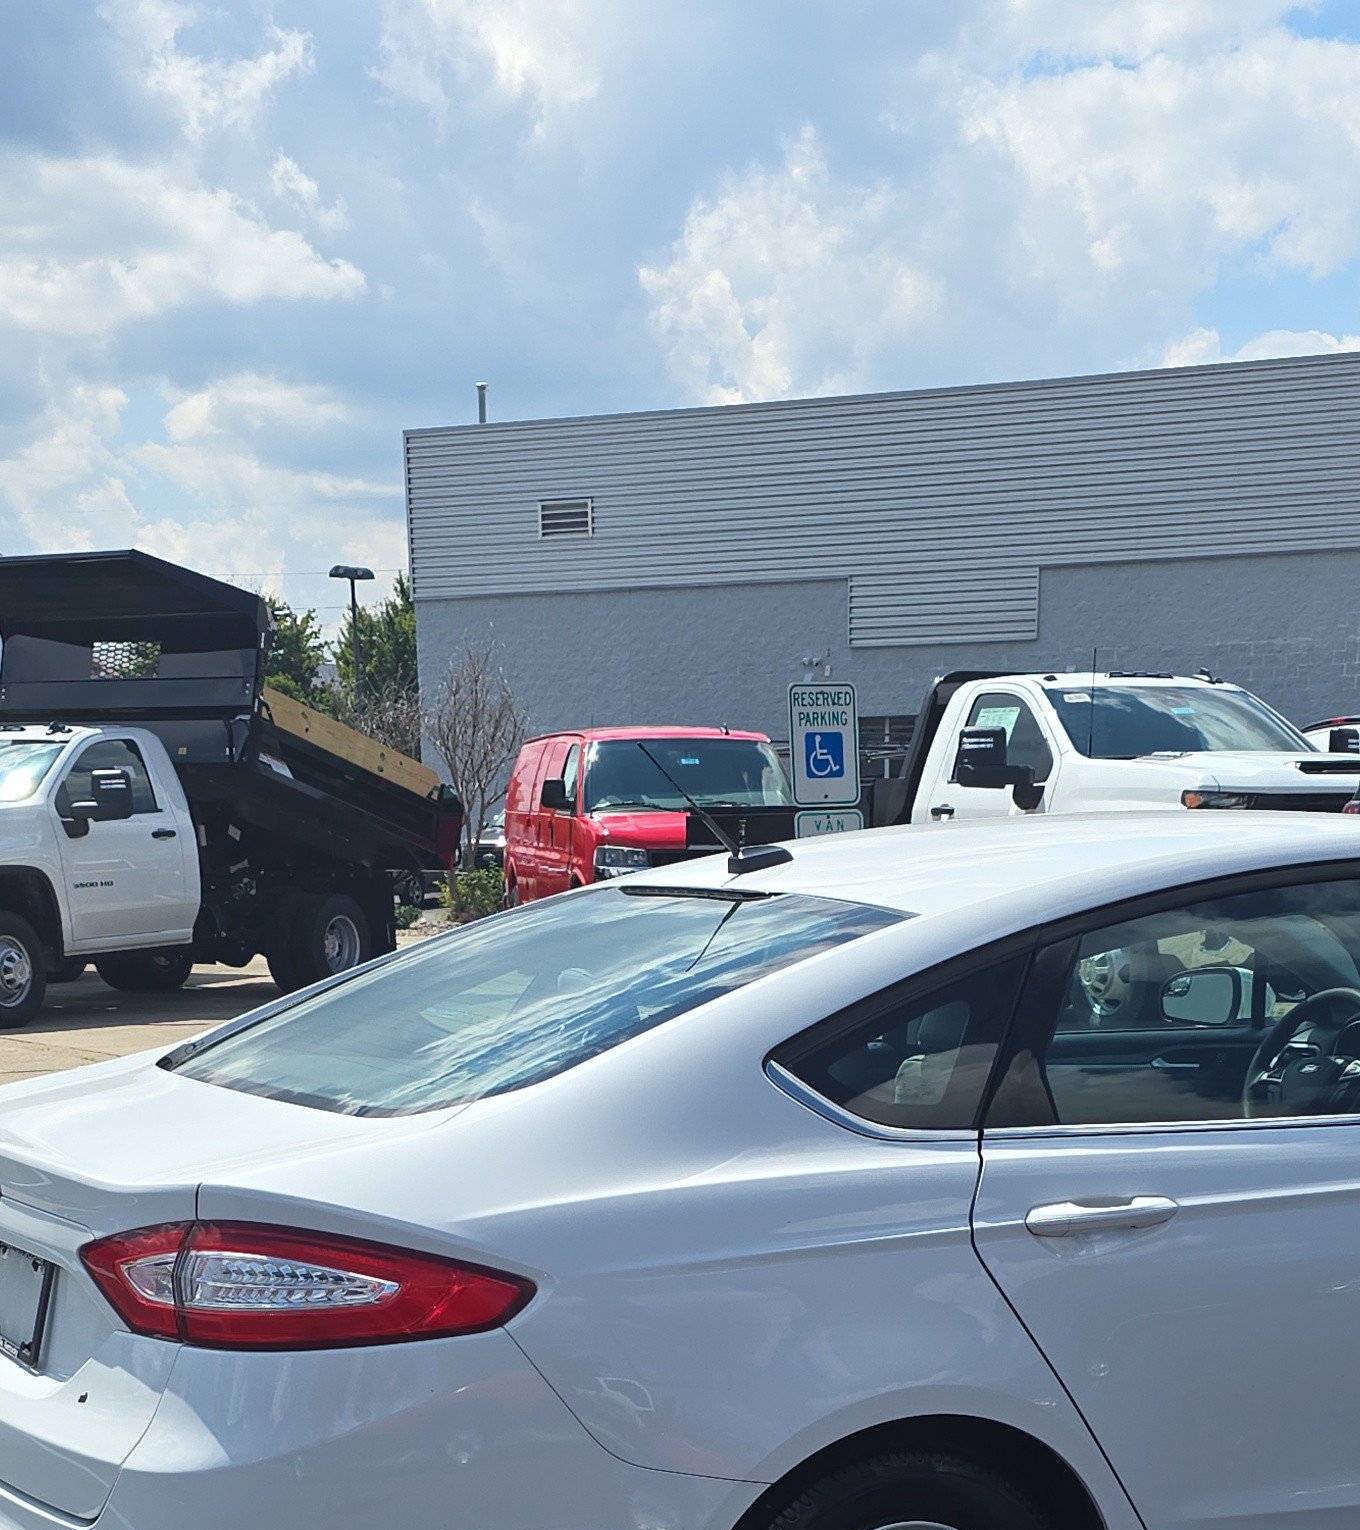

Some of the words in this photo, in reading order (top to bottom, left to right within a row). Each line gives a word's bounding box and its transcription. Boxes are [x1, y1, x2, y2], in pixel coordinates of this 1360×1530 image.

[793, 691, 852, 707] RESERVED
[798, 711, 848, 727] PARKING
[815, 819, 844, 831] VAN
